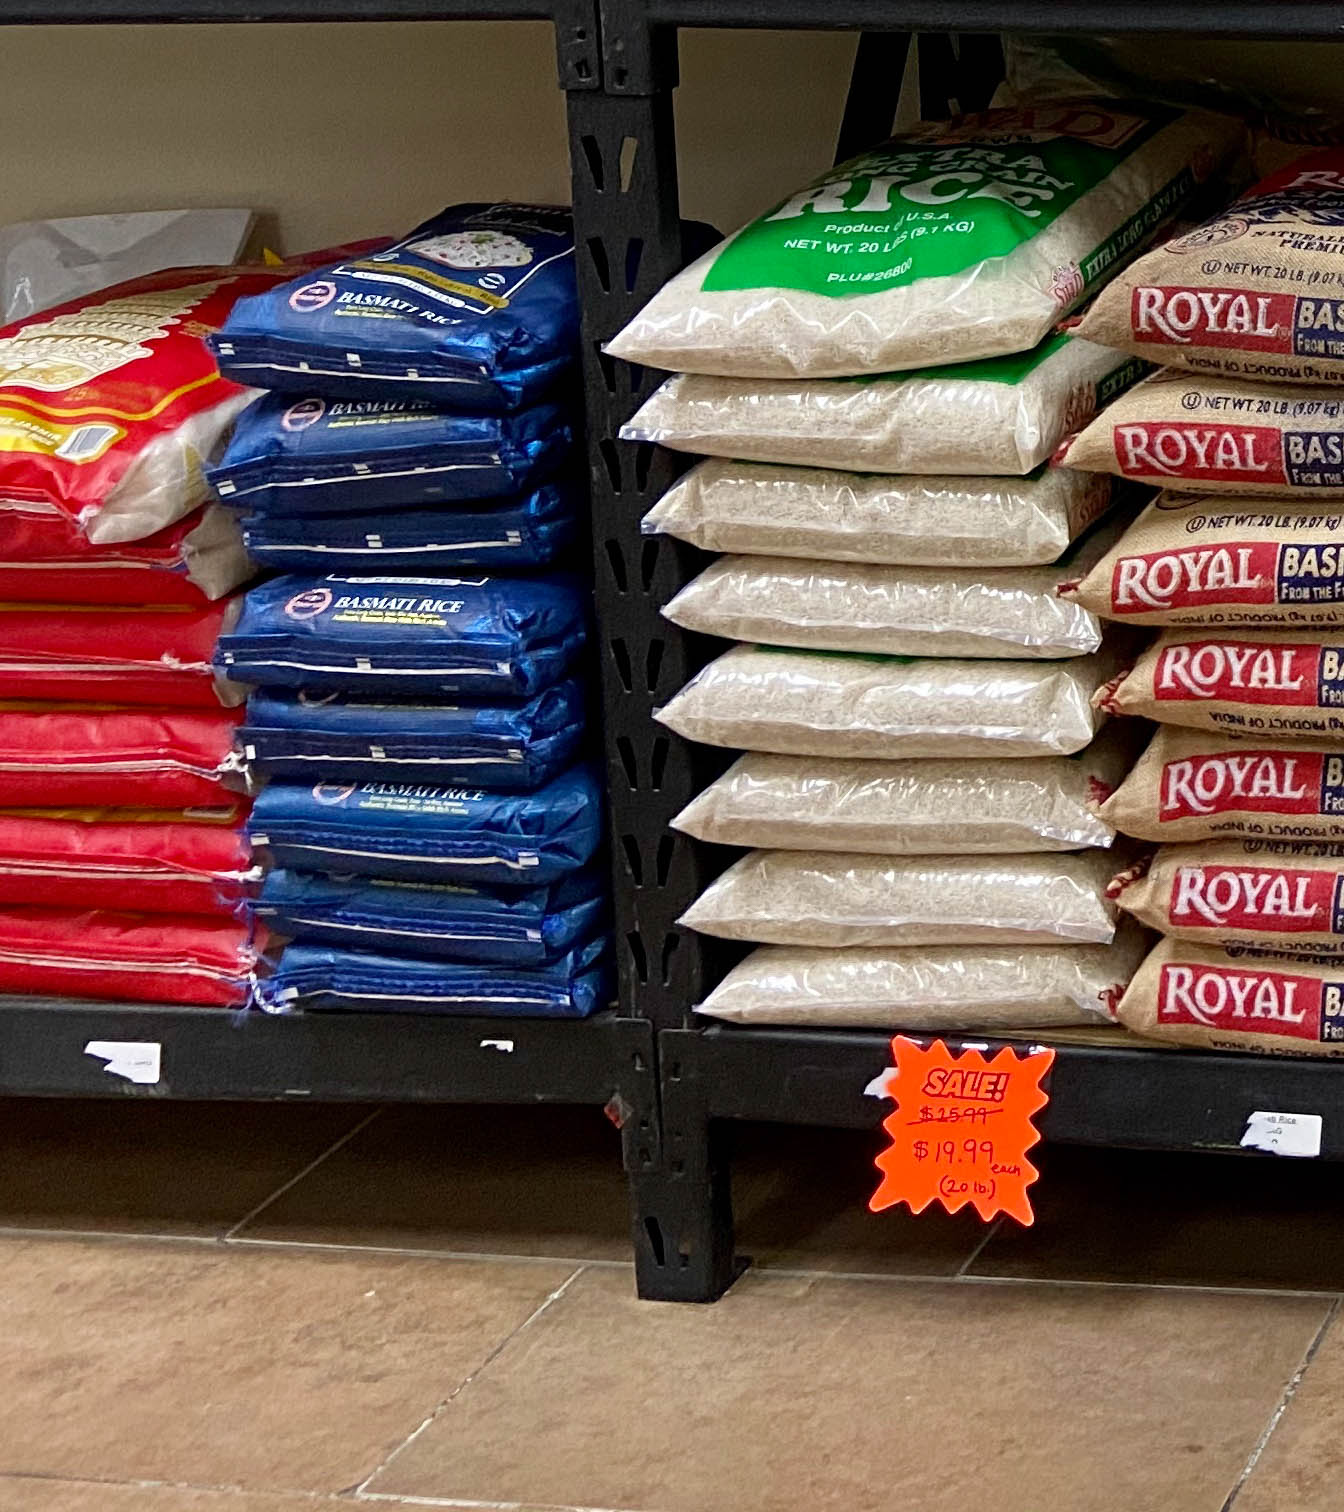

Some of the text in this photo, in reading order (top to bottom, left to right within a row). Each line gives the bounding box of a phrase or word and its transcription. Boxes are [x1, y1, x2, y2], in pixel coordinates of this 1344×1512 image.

[765, 172, 1054, 222] RICE
[784, 240, 879, 254] NET WT. 20
[1136, 290, 1280, 343] ROYAL
[334, 595, 464, 614] BASMATI RICE
[922, 1068, 1010, 1102] SALE!
